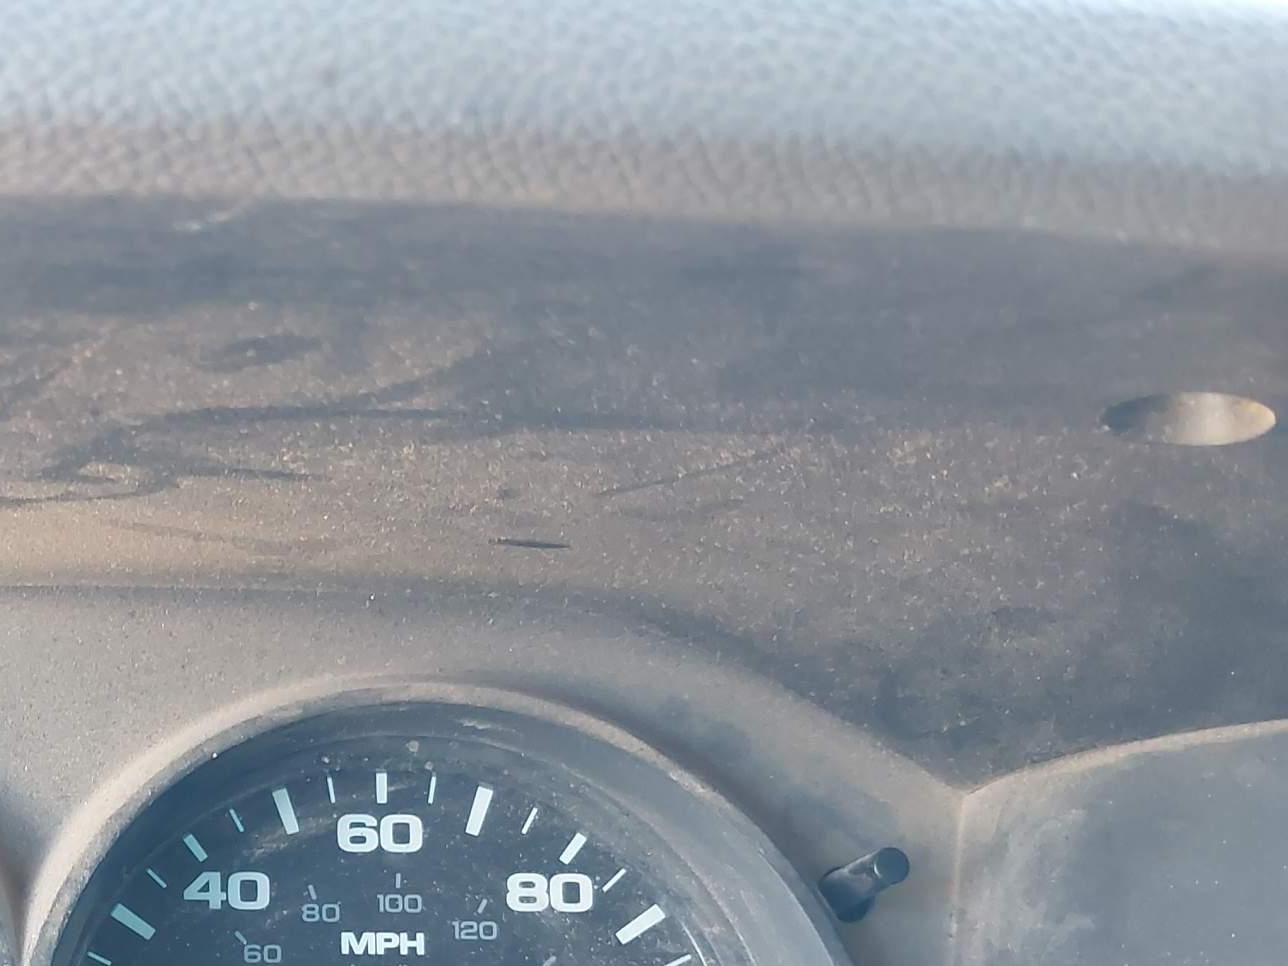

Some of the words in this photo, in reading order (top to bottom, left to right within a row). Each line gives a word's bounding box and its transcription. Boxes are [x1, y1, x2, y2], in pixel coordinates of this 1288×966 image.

[337, 813, 424, 853] 60
[183, 871, 271, 911] 40
[506, 872, 593, 913] 80
[301, 903, 340, 923] 80
[377, 894, 422, 914] 100
[452, 921, 498, 941] 120
[243, 944, 282, 964] 60
[340, 931, 425, 955] MPH
